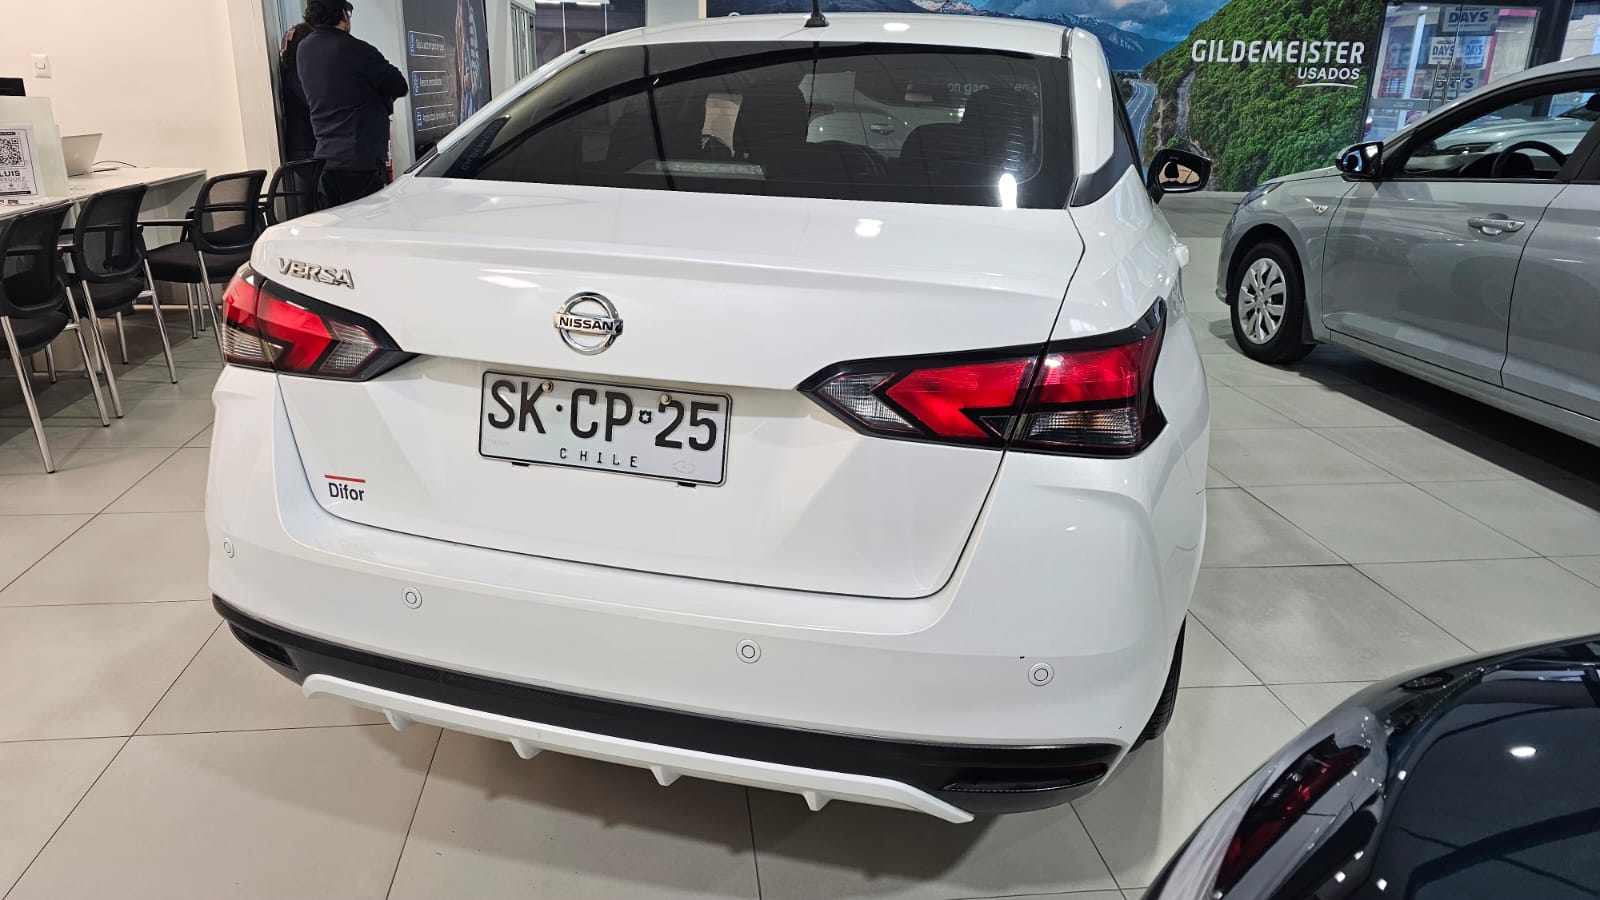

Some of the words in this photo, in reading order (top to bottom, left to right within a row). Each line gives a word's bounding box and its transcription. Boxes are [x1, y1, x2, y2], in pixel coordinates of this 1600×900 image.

[1448, 11, 1489, 23] DAYS
[1191, 39, 1365, 64] GILDEMEISTER
[1432, 44, 1455, 56] DAYS
[1465, 44, 1484, 57] DAYS
[1297, 67, 1360, 80] USADOS
[278, 257, 355, 290] VERSA
[559, 317, 614, 331] NISSAN
[559, 447, 639, 468] CHILE
[328, 482, 364, 501] Difor
